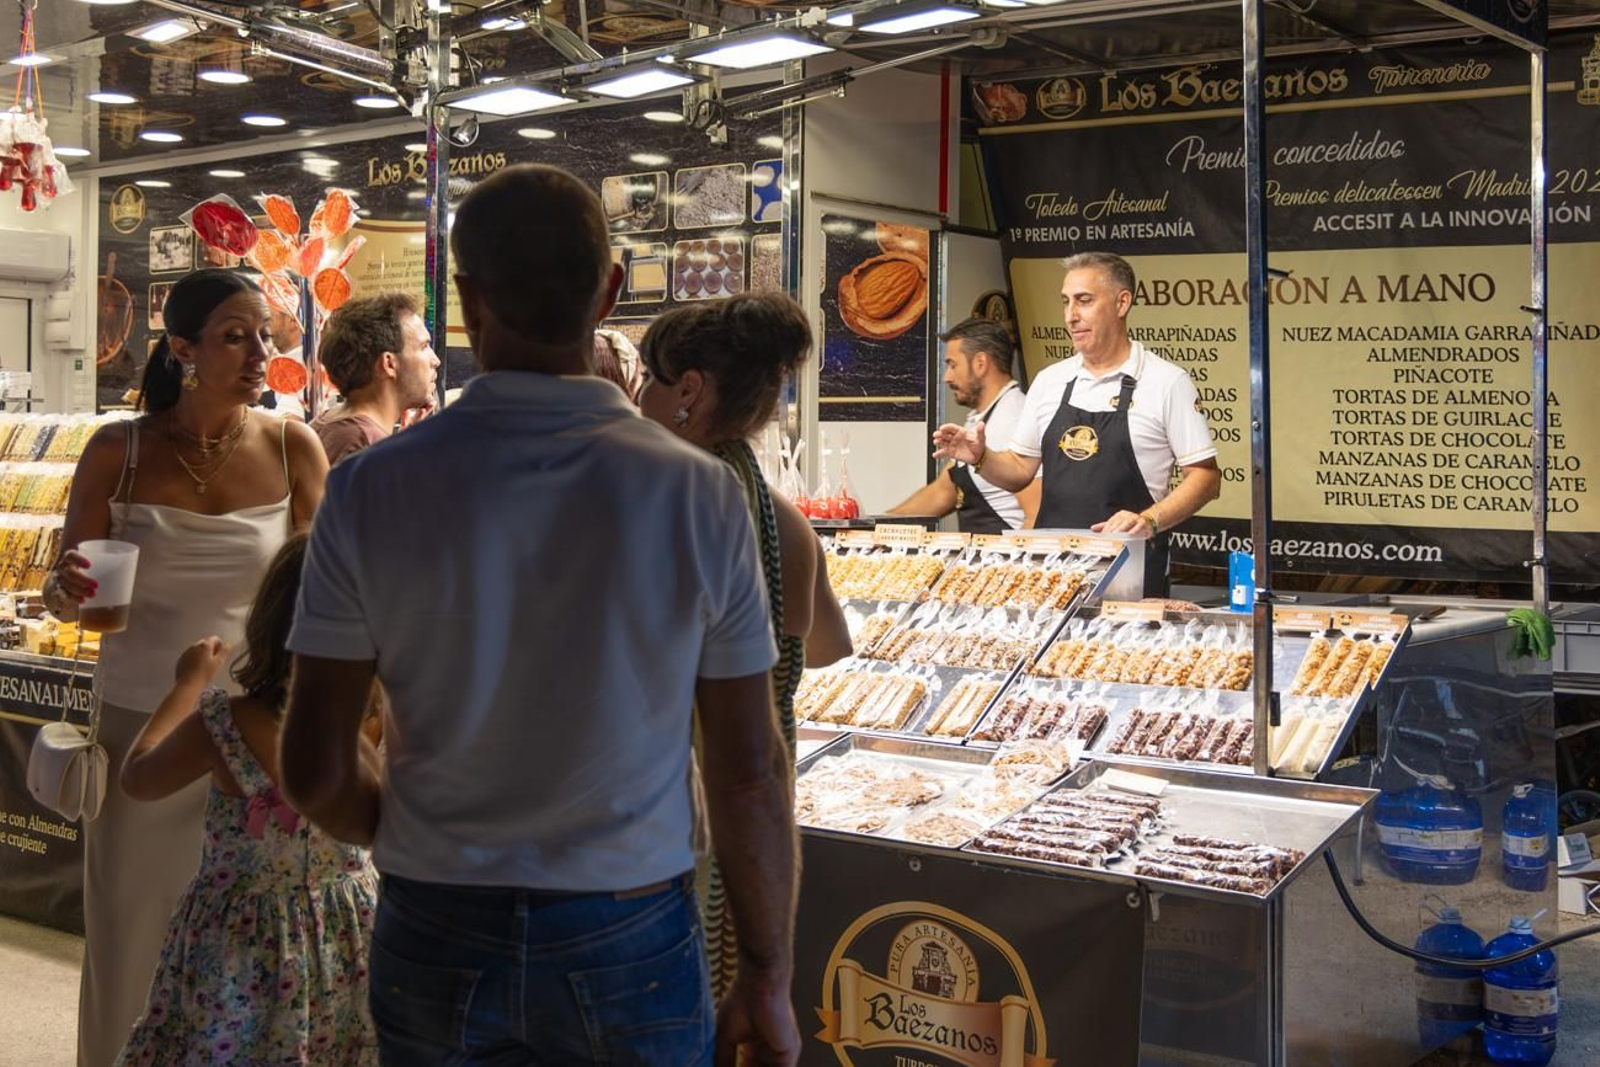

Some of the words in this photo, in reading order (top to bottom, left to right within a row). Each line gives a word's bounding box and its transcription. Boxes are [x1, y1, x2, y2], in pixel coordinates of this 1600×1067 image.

[1100, 69, 1157, 112] Los
[1160, 64, 1348, 107] Baeanos
[1273, 130, 1404, 166] concedidos
[368, 157, 401, 187] Los
[403, 150, 506, 182] Bzanos
[1265, 179, 1328, 206] Premios
[1333, 179, 1442, 204] delicatessen
[1447, 169, 1533, 199] Madri
[1025, 192, 1078, 219] Toledo
[1083, 188, 1169, 221] Artesanal
[1313, 212, 1394, 232] ACCESIT
[1399, 211, 1415, 228] A
[1421, 210, 1443, 228] LA
[1450, 201, 1591, 228] INNOVAIÓN
[1025, 226, 1081, 242] PREMIO
[1086, 225, 1106, 240] EN
[1110, 217, 1195, 239] ARTESANÍA
[1340, 274, 1366, 304] A
[1378, 272, 1496, 304] MANO
[1126, 324, 1237, 342] ARRAPIÑADAS
[1282, 327, 1332, 342] NUEZ
[1337, 325, 1458, 342] MACADAMIA
[1465, 321, 1600, 341] GARRAIÑAD
[1366, 346, 1519, 363] ALMENDRADOS
[1393, 365, 1494, 384] PIÑACOTE
[1333, 389, 1406, 405] TORTAS
[1412, 389, 1438, 405] DE
[1444, 389, 1560, 406] ALMENOA
[1333, 410, 1406, 426] TORTAS
[1412, 411, 1438, 426] DE
[1444, 411, 1562, 428] GUIRLACE
[1331, 431, 1404, 447] TORTAS
[1410, 432, 1436, 447] DE
[1319, 451, 1427, 468] MANZANAS
[1433, 453, 1459, 469] DE
[1316, 471, 1423, 488] MANZANAS
[1429, 474, 1456, 489] DE
[1461, 474, 1587, 492] CHOCOATE
[1324, 492, 1425, 509] PIRULETAS
[1431, 495, 1458, 510] DE
[9, 814, 26, 828] con
[28, 814, 78, 841] Almendras
[7, 833, 47, 854] crujiente
[890, 934, 911, 974] PURA
[915, 924, 976, 987] ARTESANIA
[900, 995, 926, 1018] Los
[864, 992, 998, 1055] Baezanos
